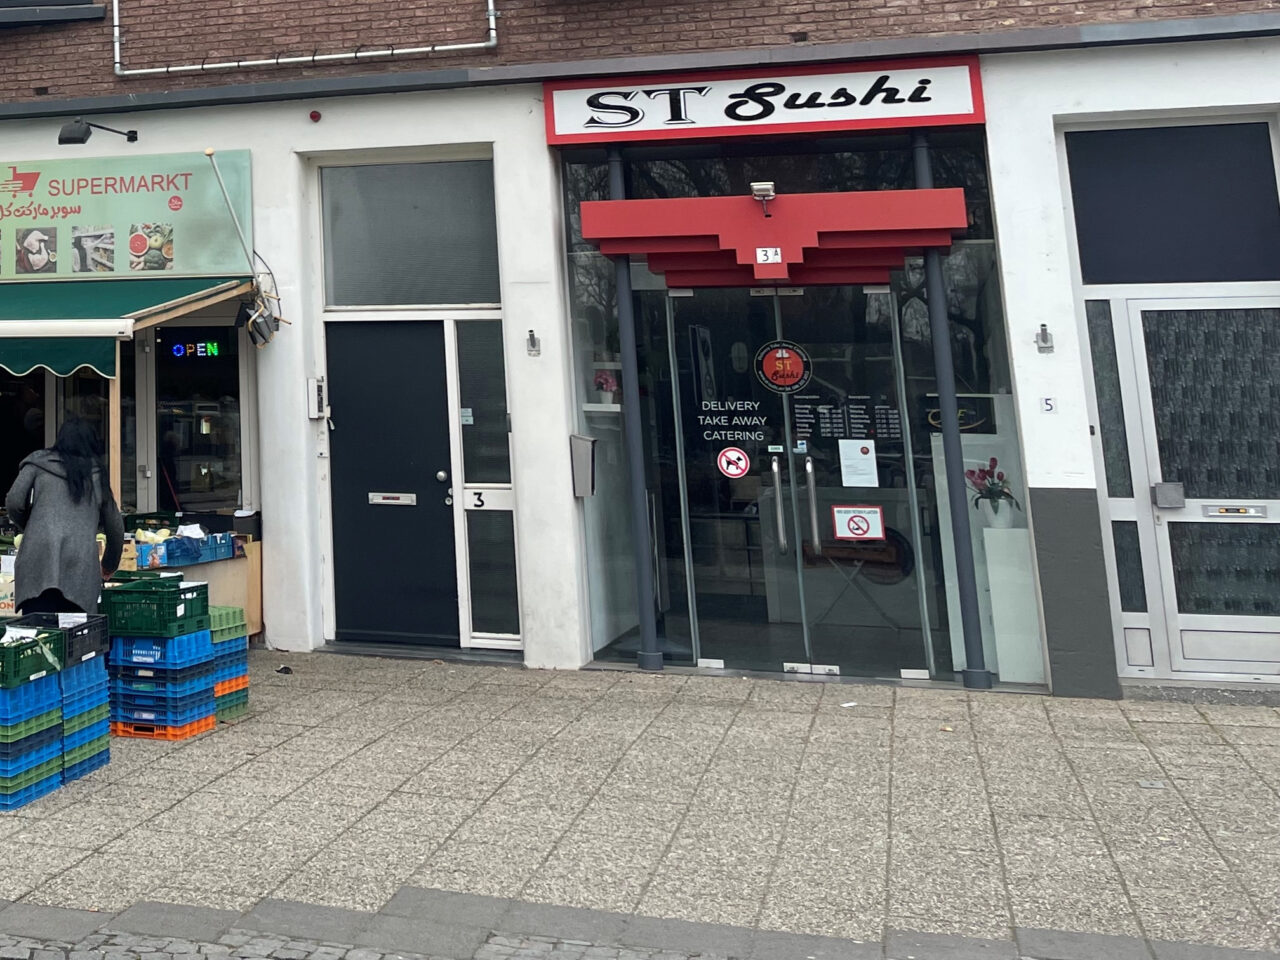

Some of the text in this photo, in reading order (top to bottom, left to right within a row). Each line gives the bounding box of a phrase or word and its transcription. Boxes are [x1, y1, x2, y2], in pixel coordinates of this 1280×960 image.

[583, 74, 933, 129] ST Sushi
[48, 173, 193, 197] SUPERMARKT
[172, 343, 219, 357] OPEN
[775, 360, 792, 371] ST
[701, 401, 760, 411] DELIVERY
[1044, 398, 1053, 411] 5
[698, 416, 767, 426] TAKE AWAY
[703, 431, 764, 441] CATERING
[473, 492, 484, 508] 3
